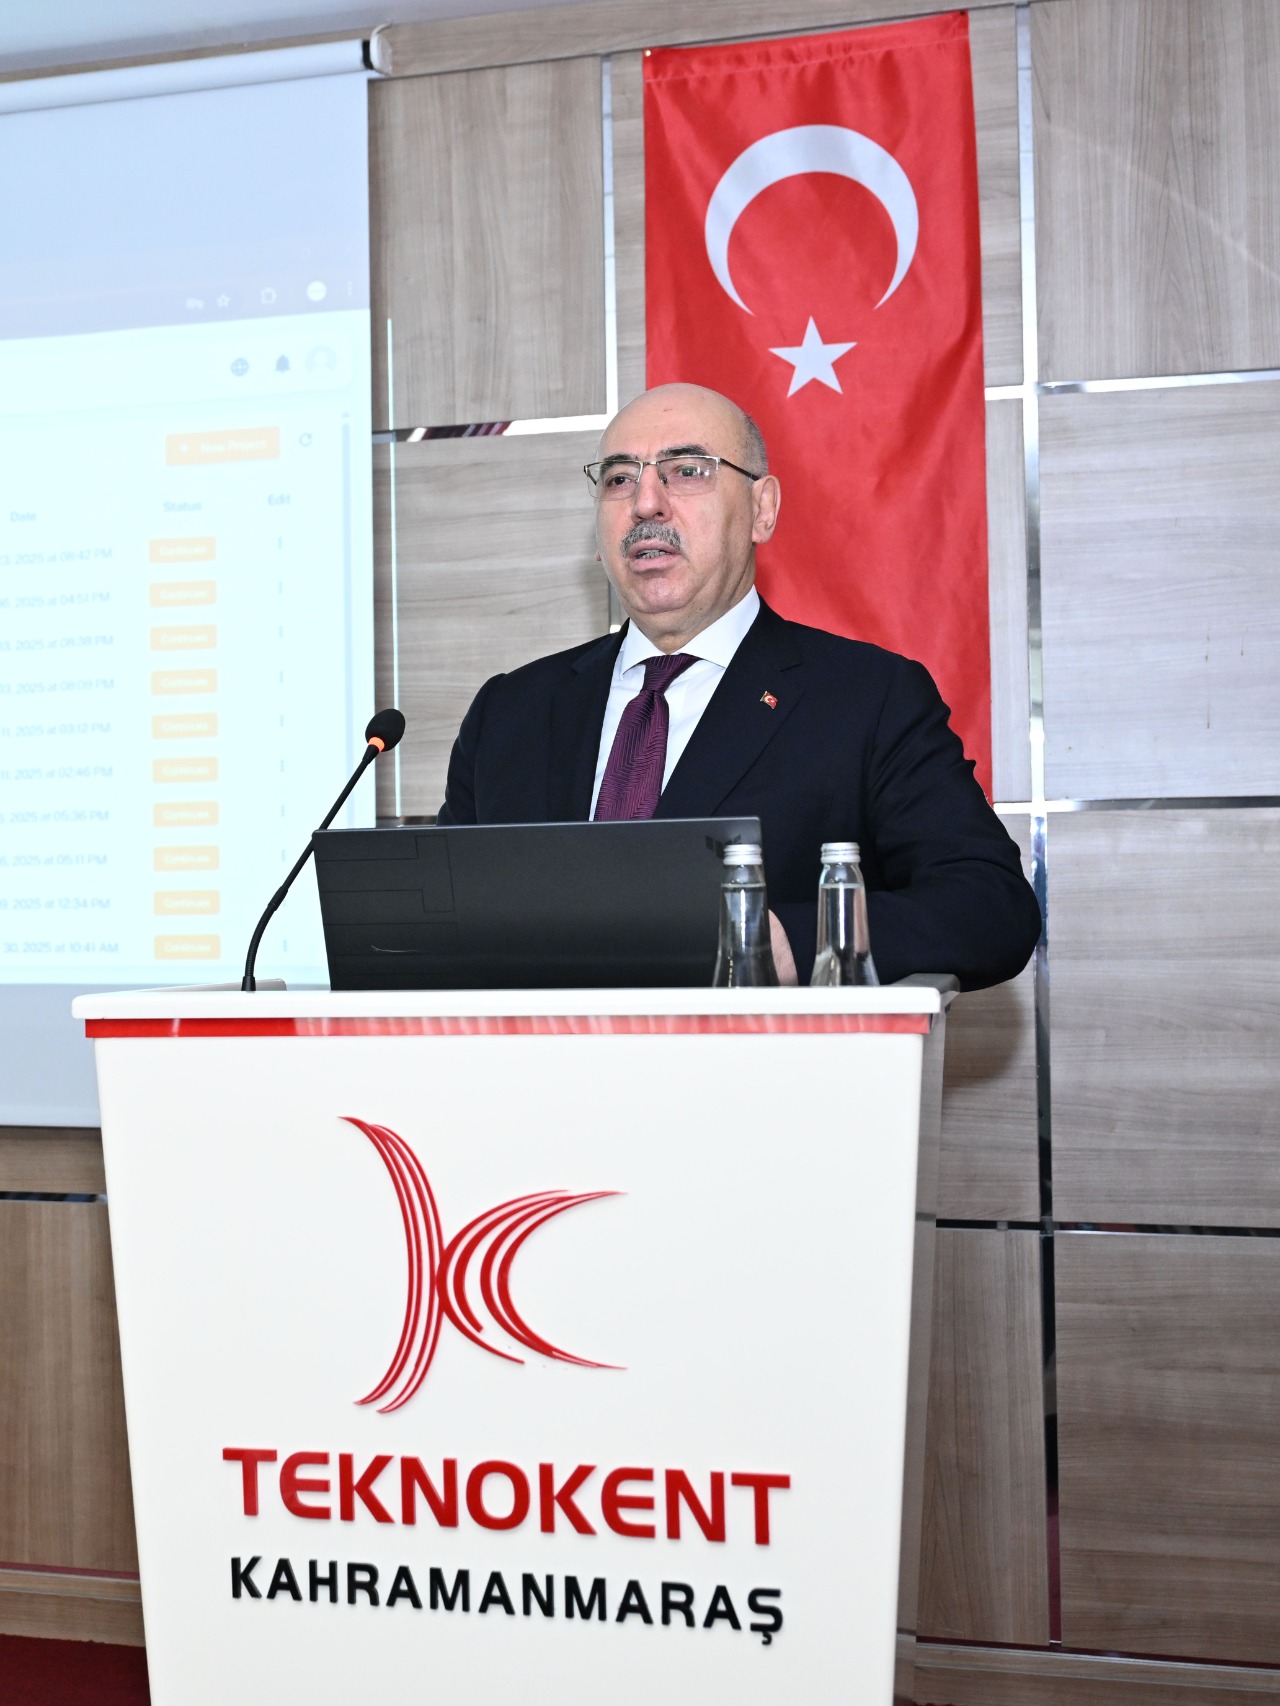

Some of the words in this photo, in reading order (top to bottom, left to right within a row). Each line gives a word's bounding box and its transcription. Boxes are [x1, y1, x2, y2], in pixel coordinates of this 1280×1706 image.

[162, 500, 203, 513] Status
[267, 493, 292, 507] Edit
[9, 510, 38, 523] Date
[15, 552, 44, 565] 2025
[94, 547, 112, 559] PM
[15, 595, 45, 608] 2025
[92, 591, 111, 603] PM
[16, 638, 45, 651] 2025
[94, 634, 114, 646] PM
[16, 681, 45, 694] 2025
[95, 677, 115, 689] PM
[16, 724, 44, 737] 2025
[91, 721, 111, 733] PM
[14, 767, 43, 780] 2025
[93, 765, 113, 777] PM
[9, 811, 38, 824] 2025
[89, 809, 109, 821] PM
[12, 854, 42, 867] 2025
[87, 853, 107, 865] PM
[13, 897, 42, 910] 2025
[91, 897, 111, 909] PM
[23, 941, 52, 953] 2025
[99, 942, 120, 954] AM
[222, 1447, 791, 1546] TEKNOKENT
[230, 1555, 784, 1646] KAHRAMANMARAŞ
